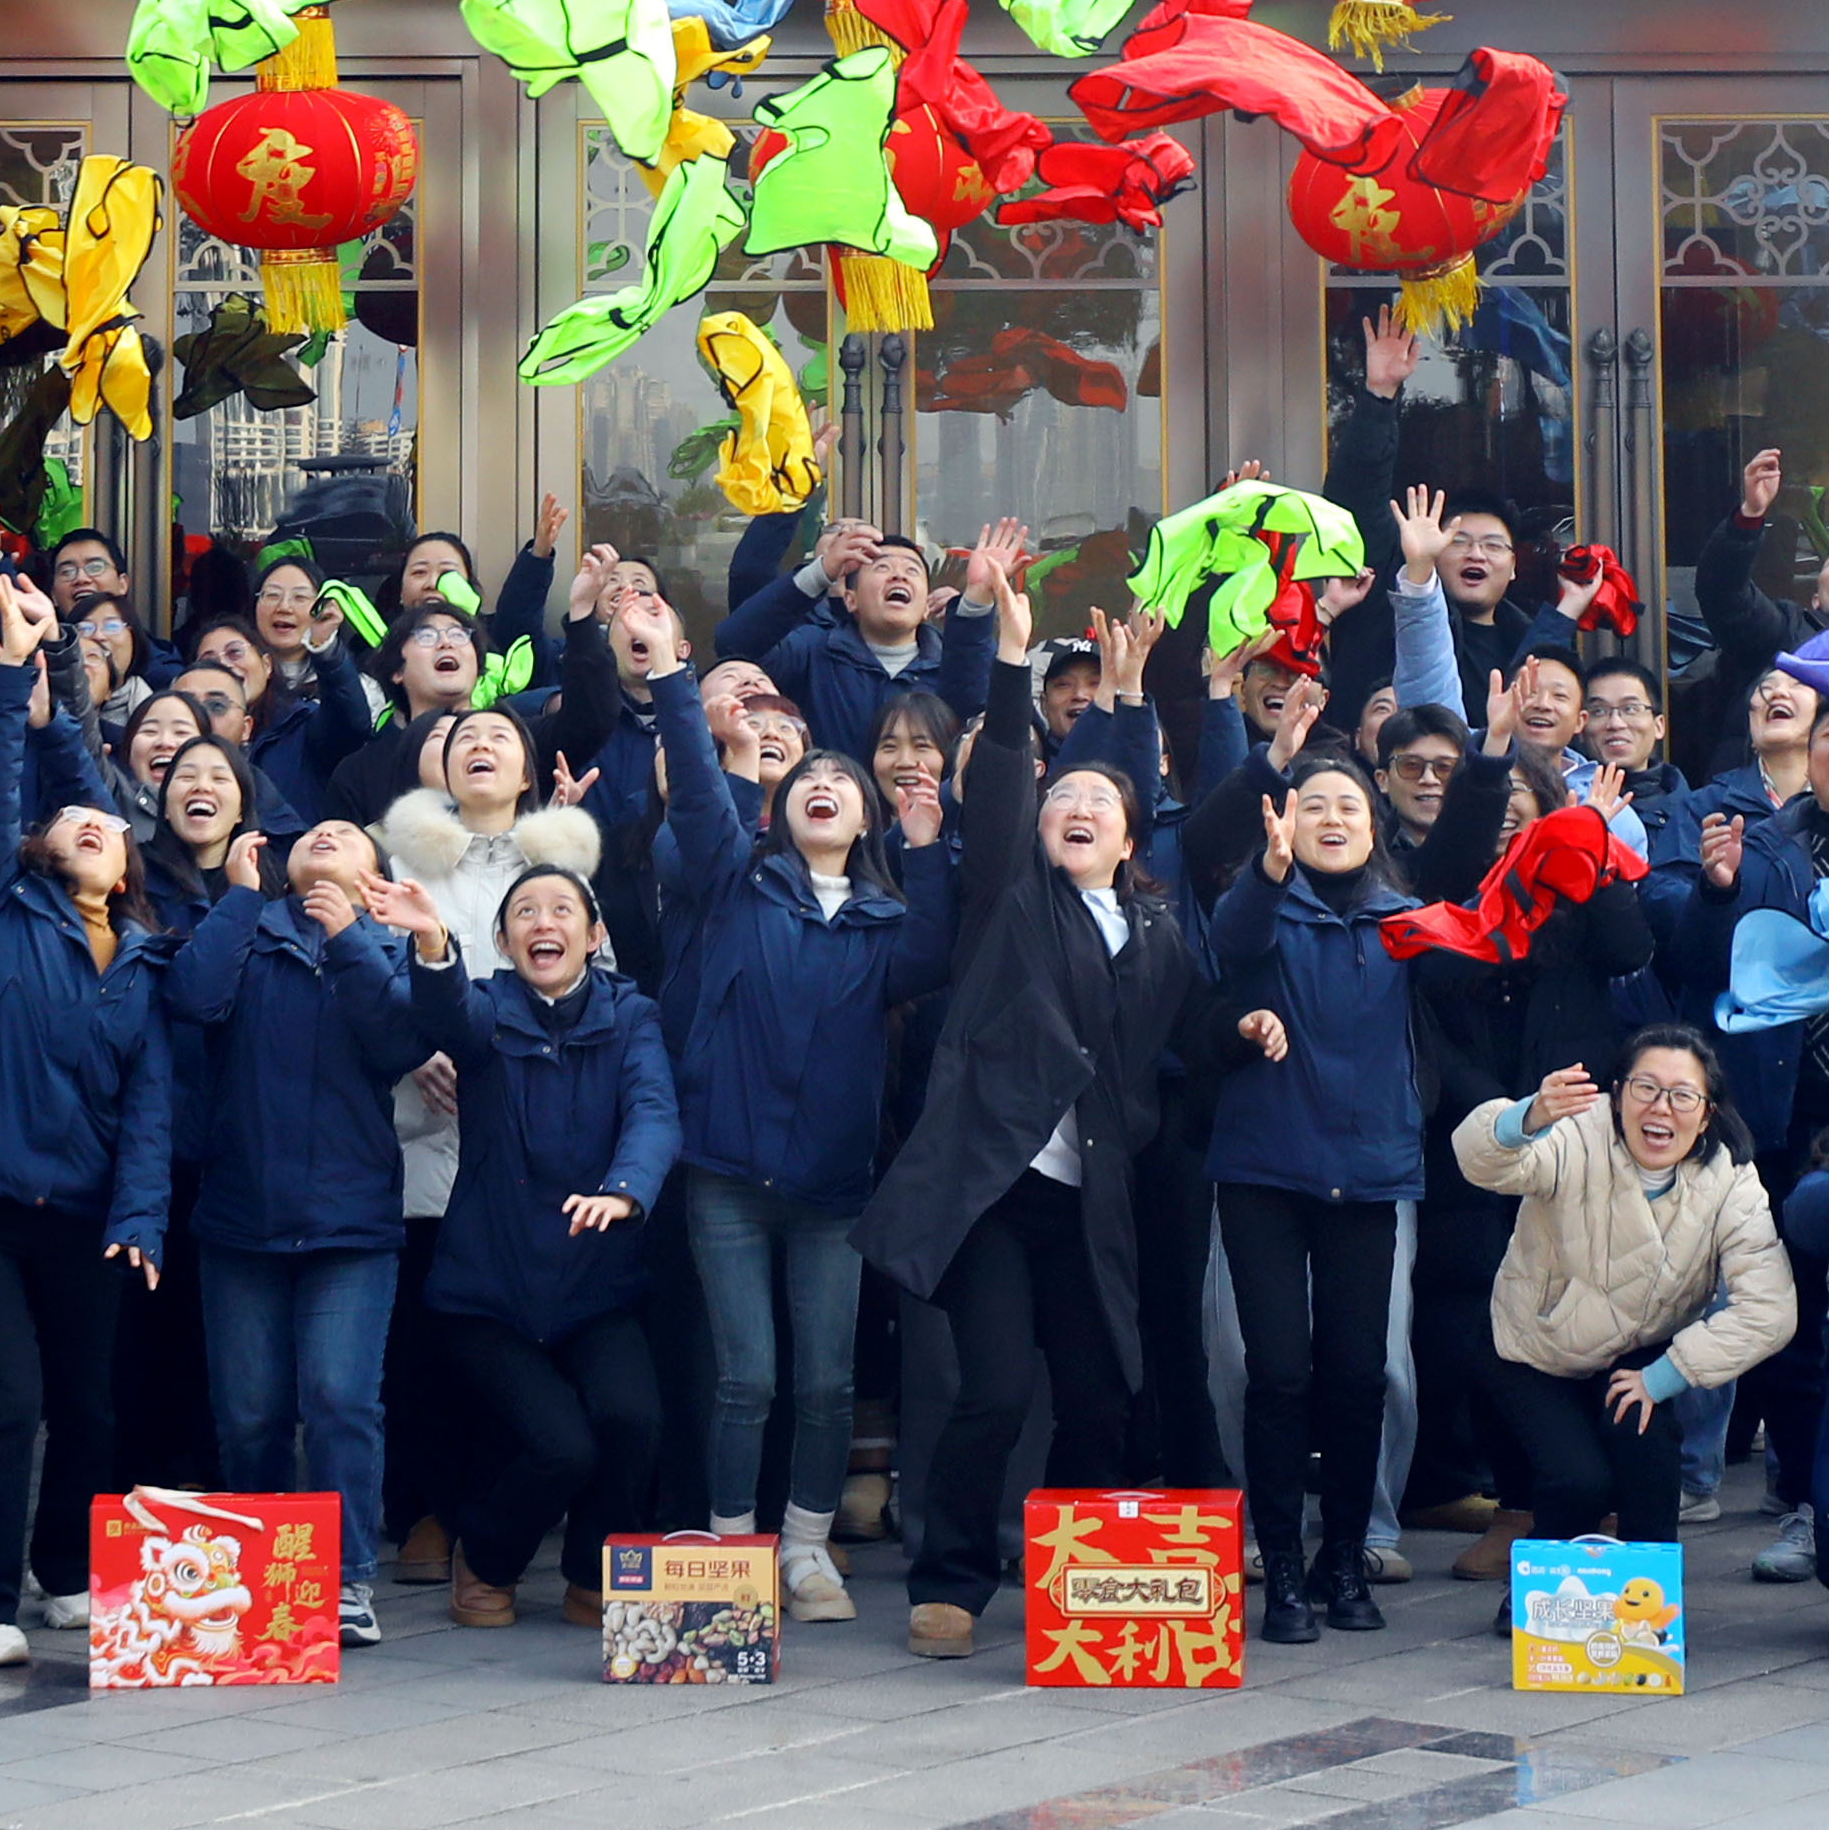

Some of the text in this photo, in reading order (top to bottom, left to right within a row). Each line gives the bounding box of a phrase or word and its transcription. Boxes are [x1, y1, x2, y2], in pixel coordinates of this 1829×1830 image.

[665, 1560, 751, 1579] 每日坚果
[1532, 1598, 1616, 1621] 成长坚果
